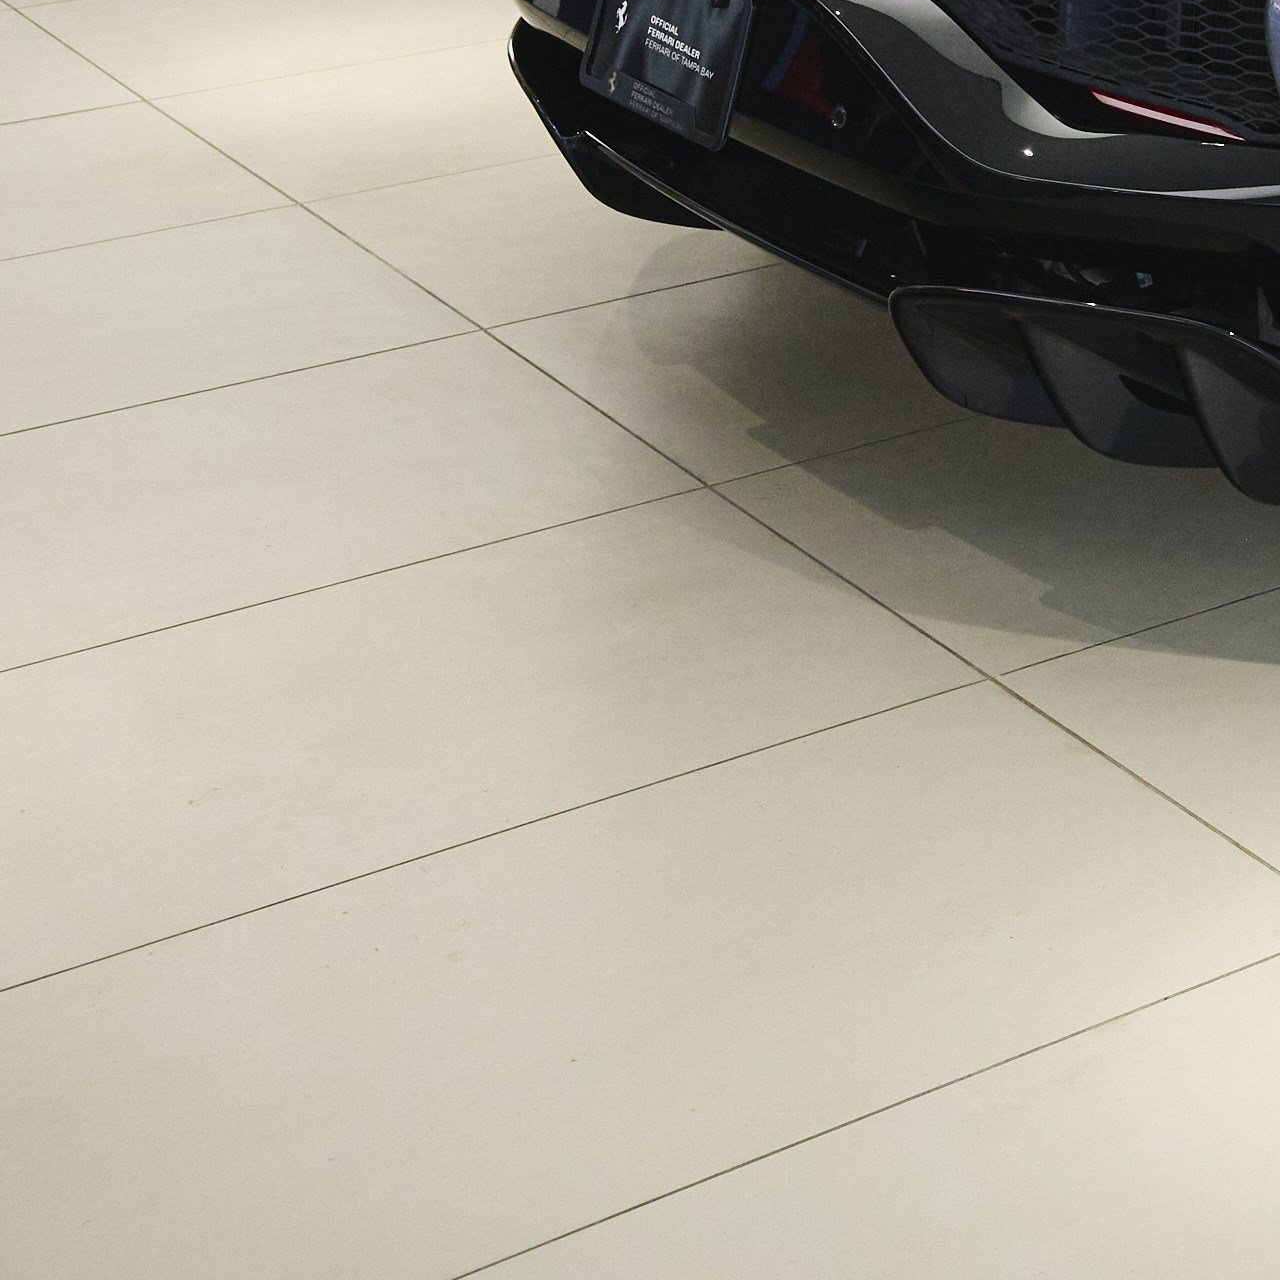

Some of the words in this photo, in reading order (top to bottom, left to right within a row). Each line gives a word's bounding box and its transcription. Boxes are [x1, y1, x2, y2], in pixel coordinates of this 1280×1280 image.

[650, 14, 679, 36] OFFICIAL
[644, 38, 671, 58] FERRARI
[671, 51, 681, 62] OF
[681, 56, 701, 74] TAMPA
[700, 66, 715, 80] BAY
[647, 26, 675, 47] FERRARI
[675, 39, 701, 60] DEALER
